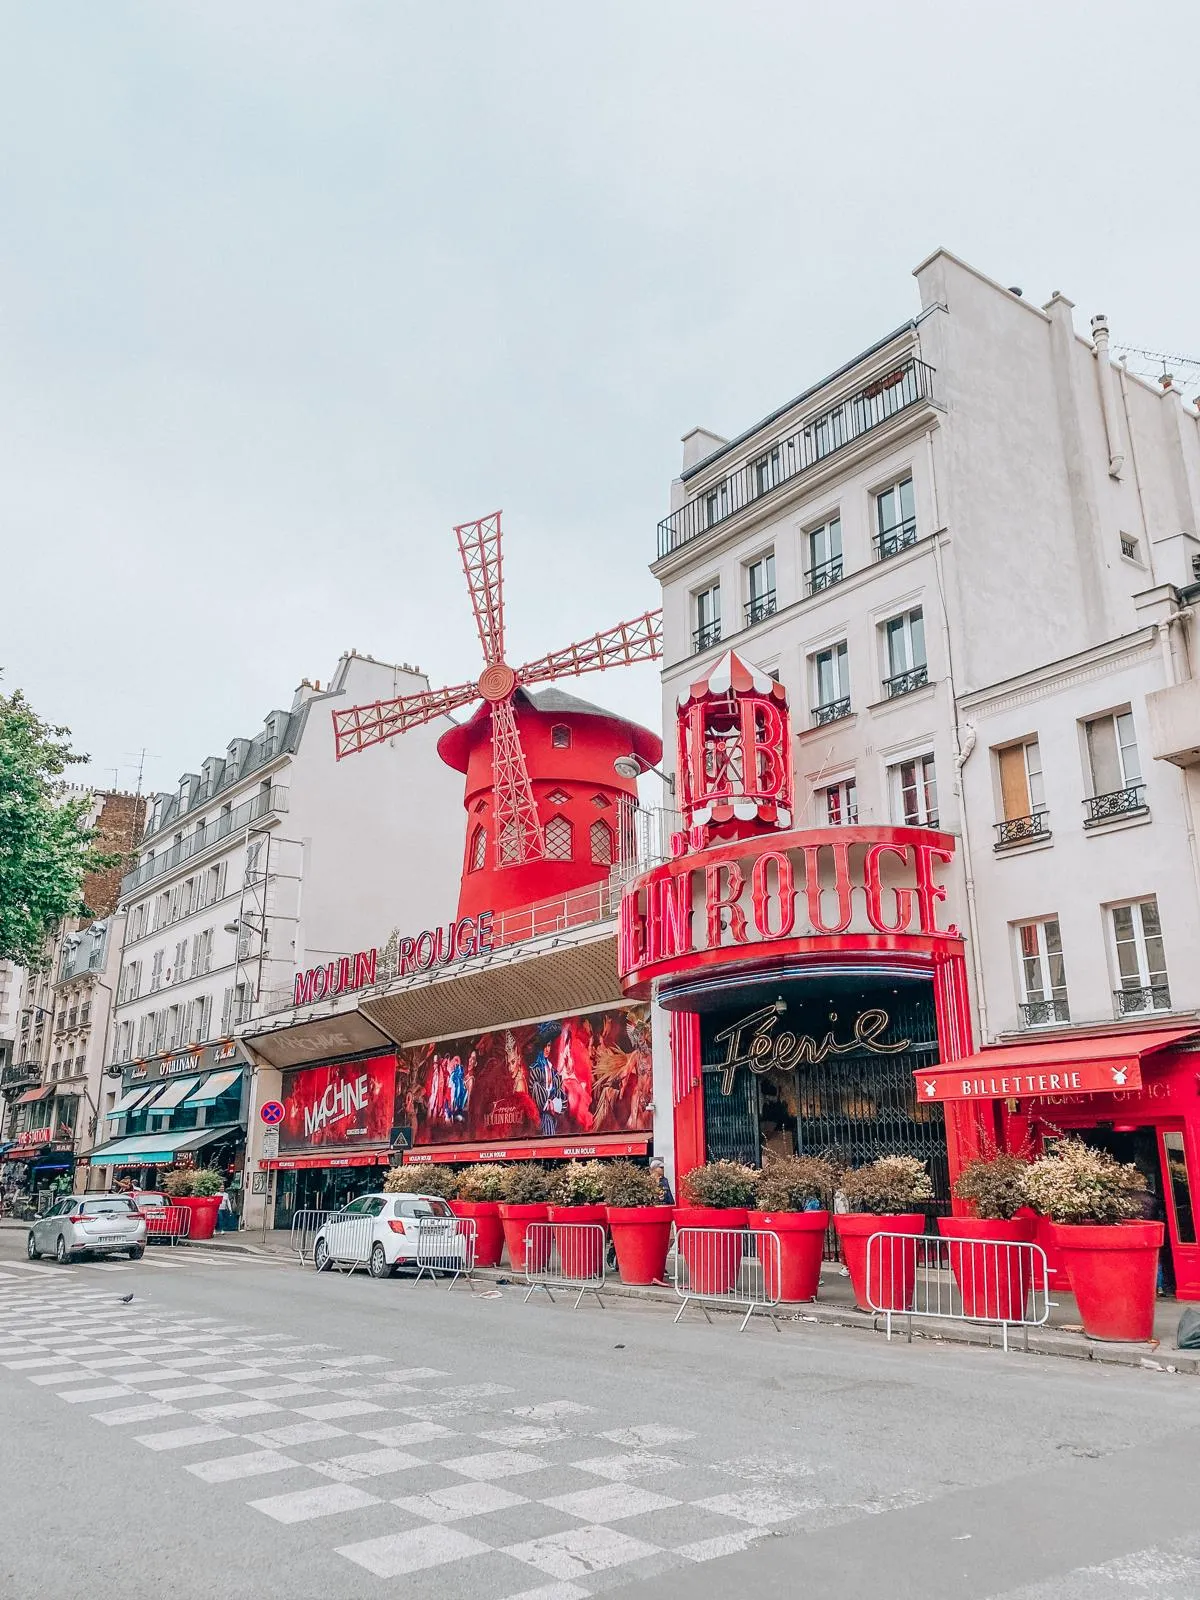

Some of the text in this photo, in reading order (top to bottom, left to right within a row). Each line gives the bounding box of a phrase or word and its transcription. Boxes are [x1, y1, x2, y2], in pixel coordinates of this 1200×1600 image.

[705, 841, 960, 948] ROUGE
[294, 910, 494, 1005] MOULIN ROUGE
[714, 1004, 911, 1096] Féerie
[962, 1072, 1081, 1095] BILLETTERIE
[304, 1074, 368, 1137] MACHINE
